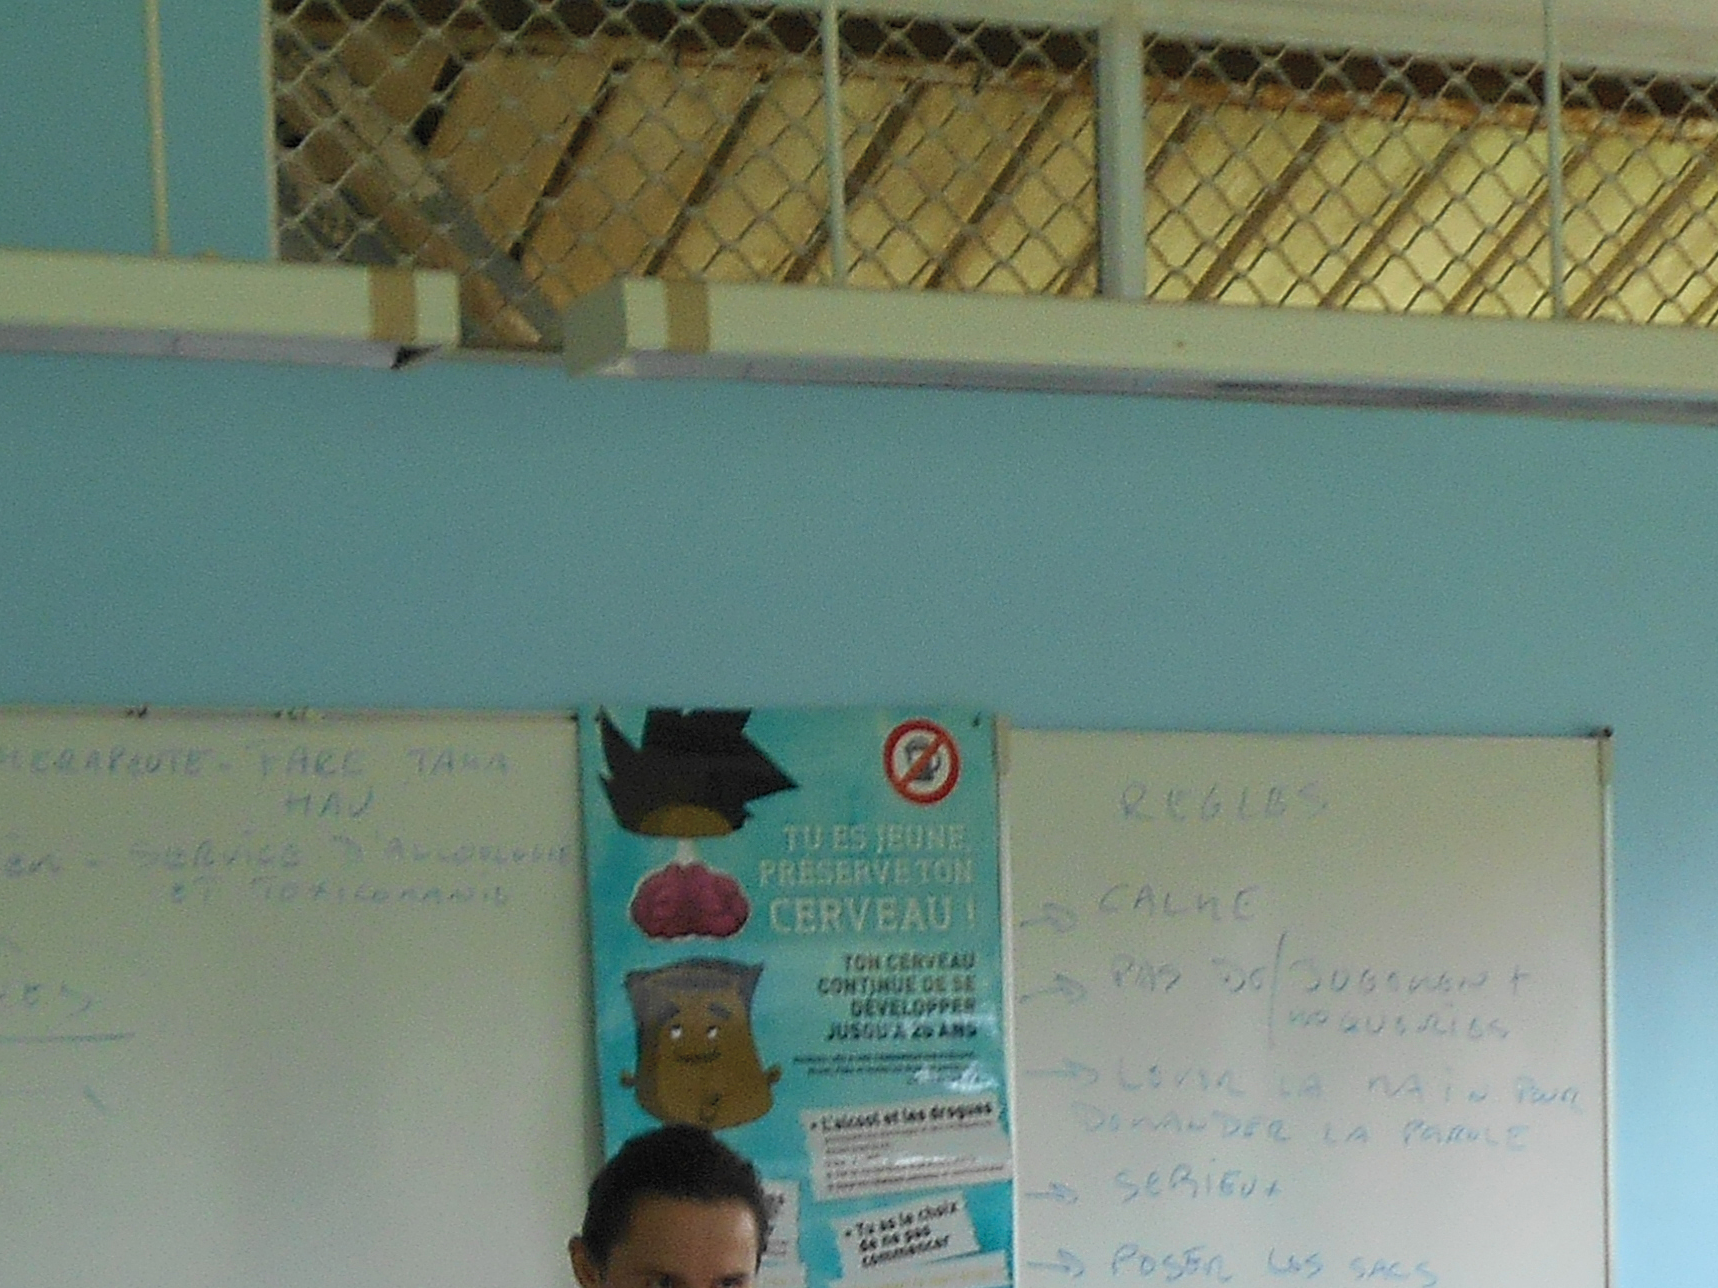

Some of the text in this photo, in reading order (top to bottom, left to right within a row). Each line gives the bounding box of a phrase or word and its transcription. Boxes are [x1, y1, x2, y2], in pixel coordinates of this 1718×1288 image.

[783, 824, 823, 852] TU
[832, 824, 867, 850] ES
[914, 858, 974, 885] TON
[769, 896, 952, 934] CERVEAU
[843, 952, 976, 972] TON CERVEAU
[816, 976, 916, 997] CONTINUE
[921, 976, 946, 994] DE
